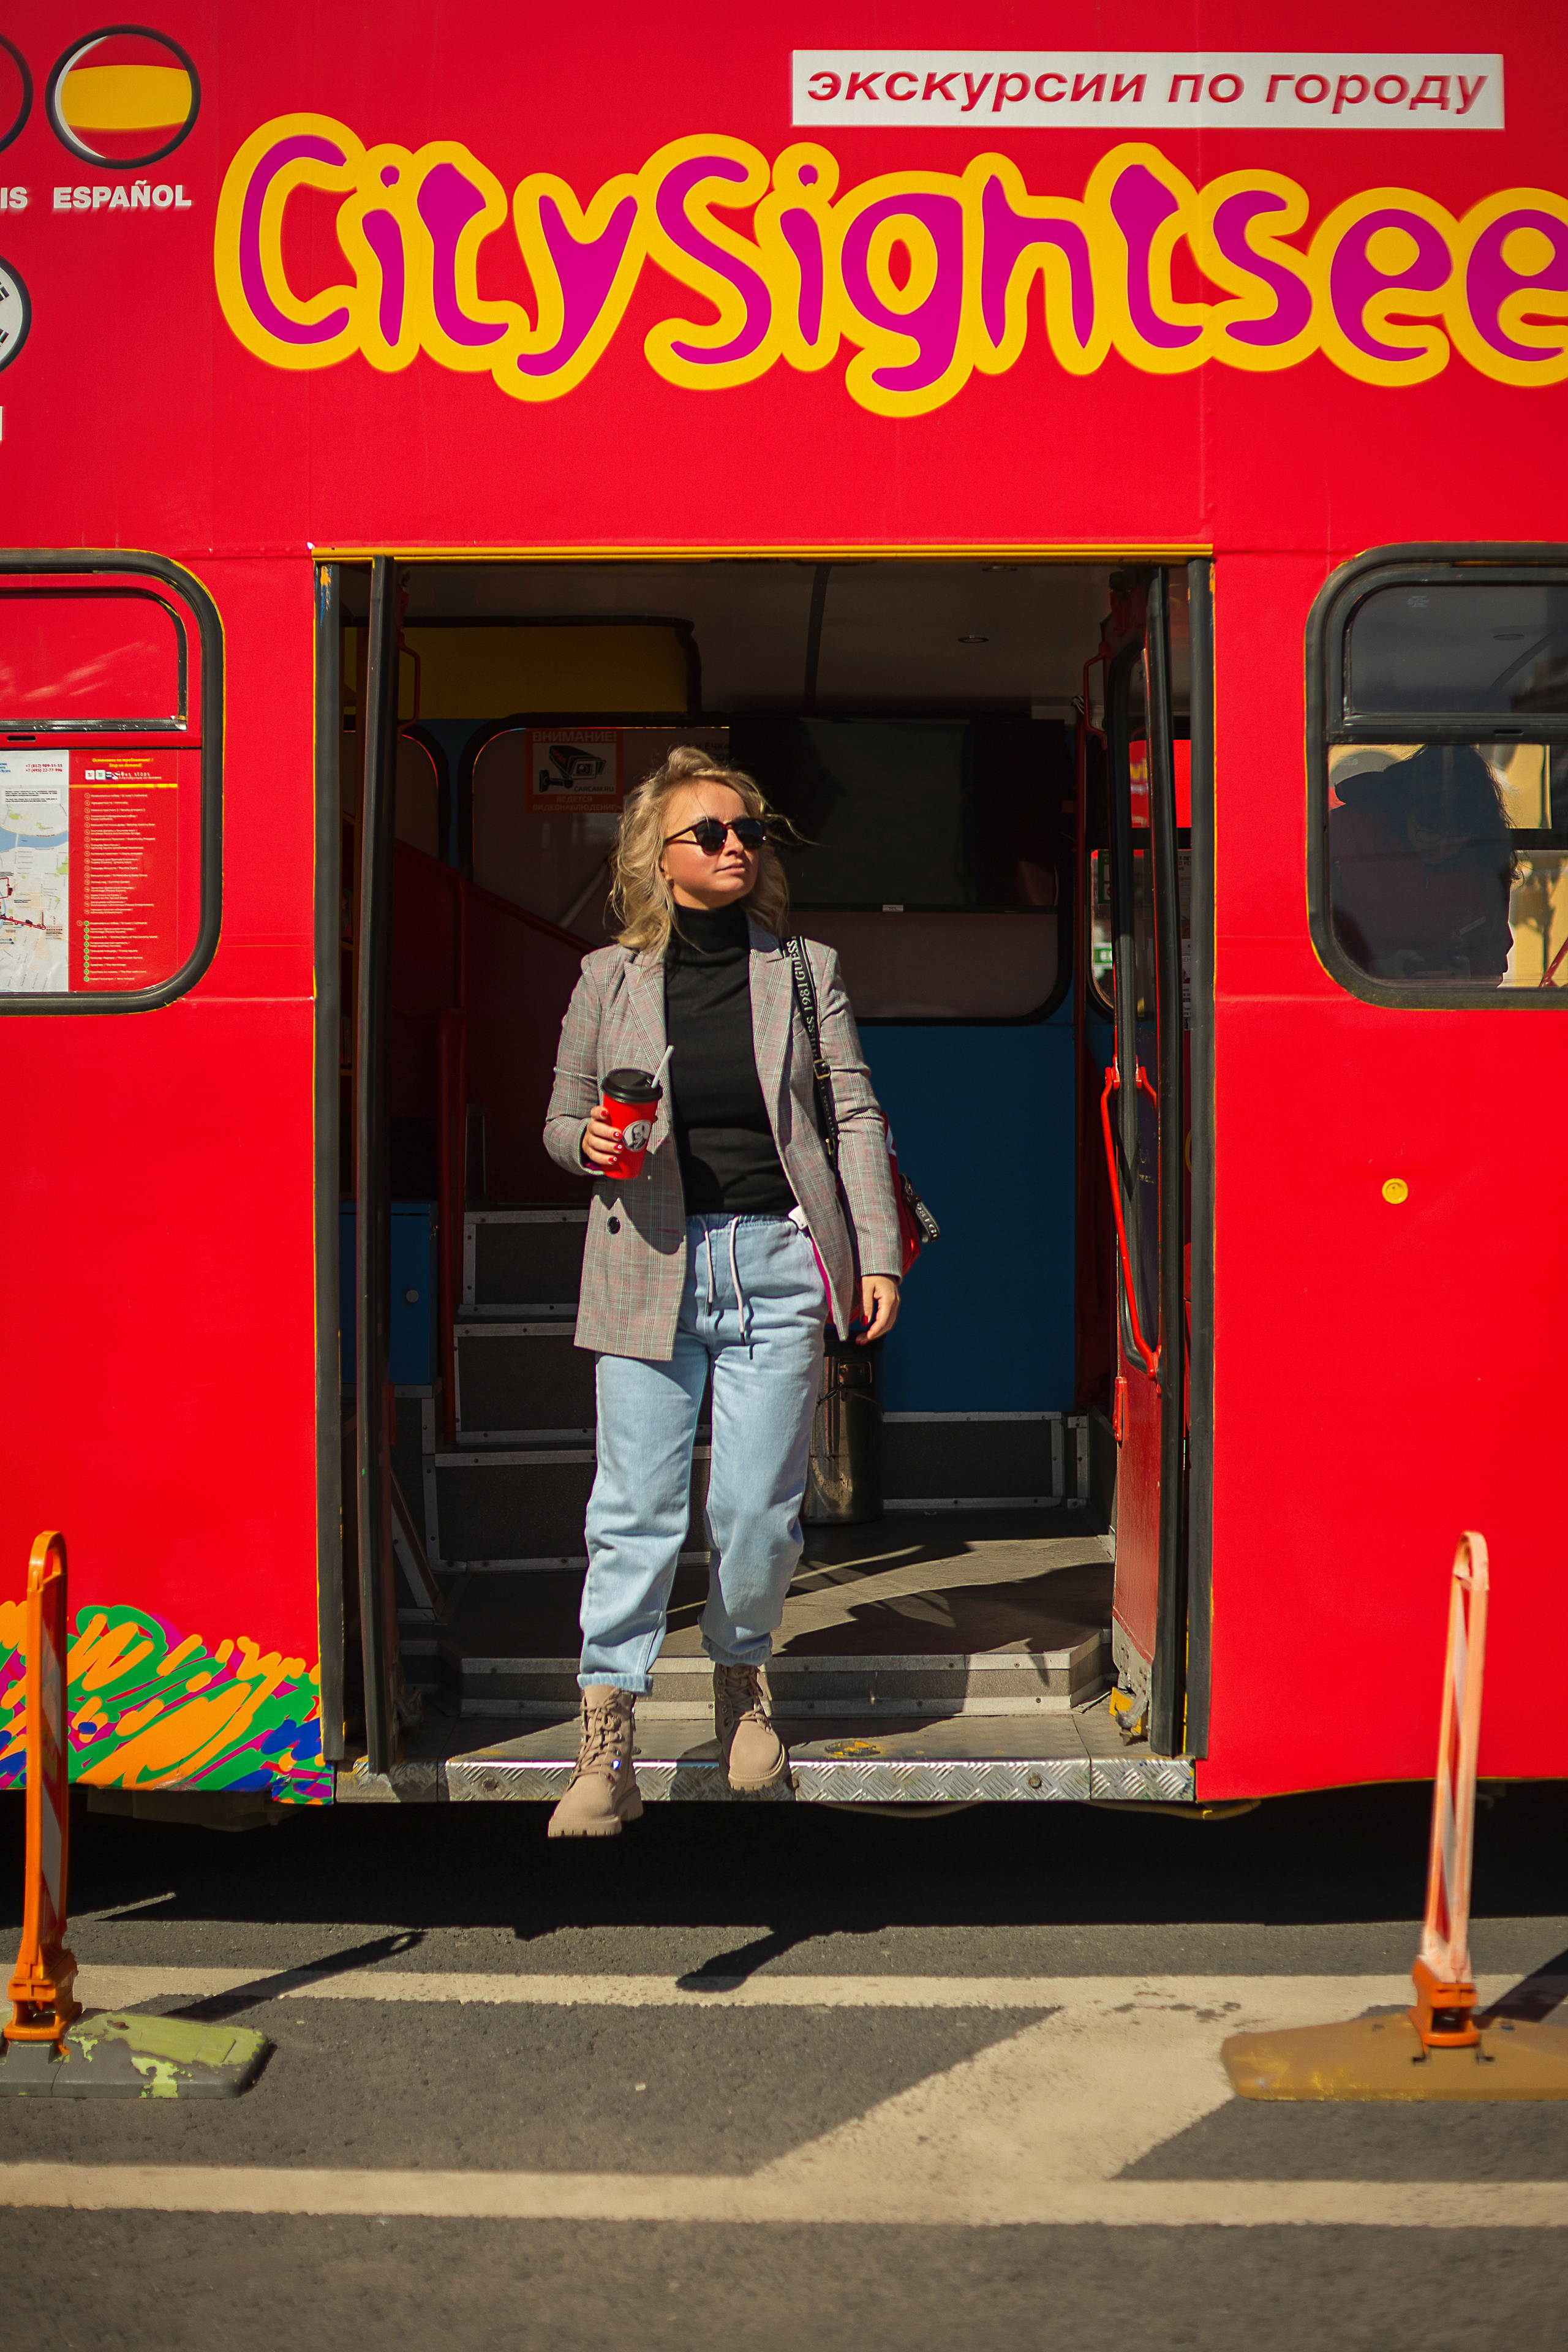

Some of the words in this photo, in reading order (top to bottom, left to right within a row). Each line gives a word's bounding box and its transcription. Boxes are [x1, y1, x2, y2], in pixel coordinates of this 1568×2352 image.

[808, 71, 1148, 112] экскурсии
[1167, 73, 1245, 103] по
[1265, 74, 1489, 115] городу
[53, 179, 192, 208] ESPAÑOL
[532, 731, 617, 742] ВНИМАНИЕ!
[786, 940, 806, 981] GUESS
[797, 982, 813, 1012] 1981
